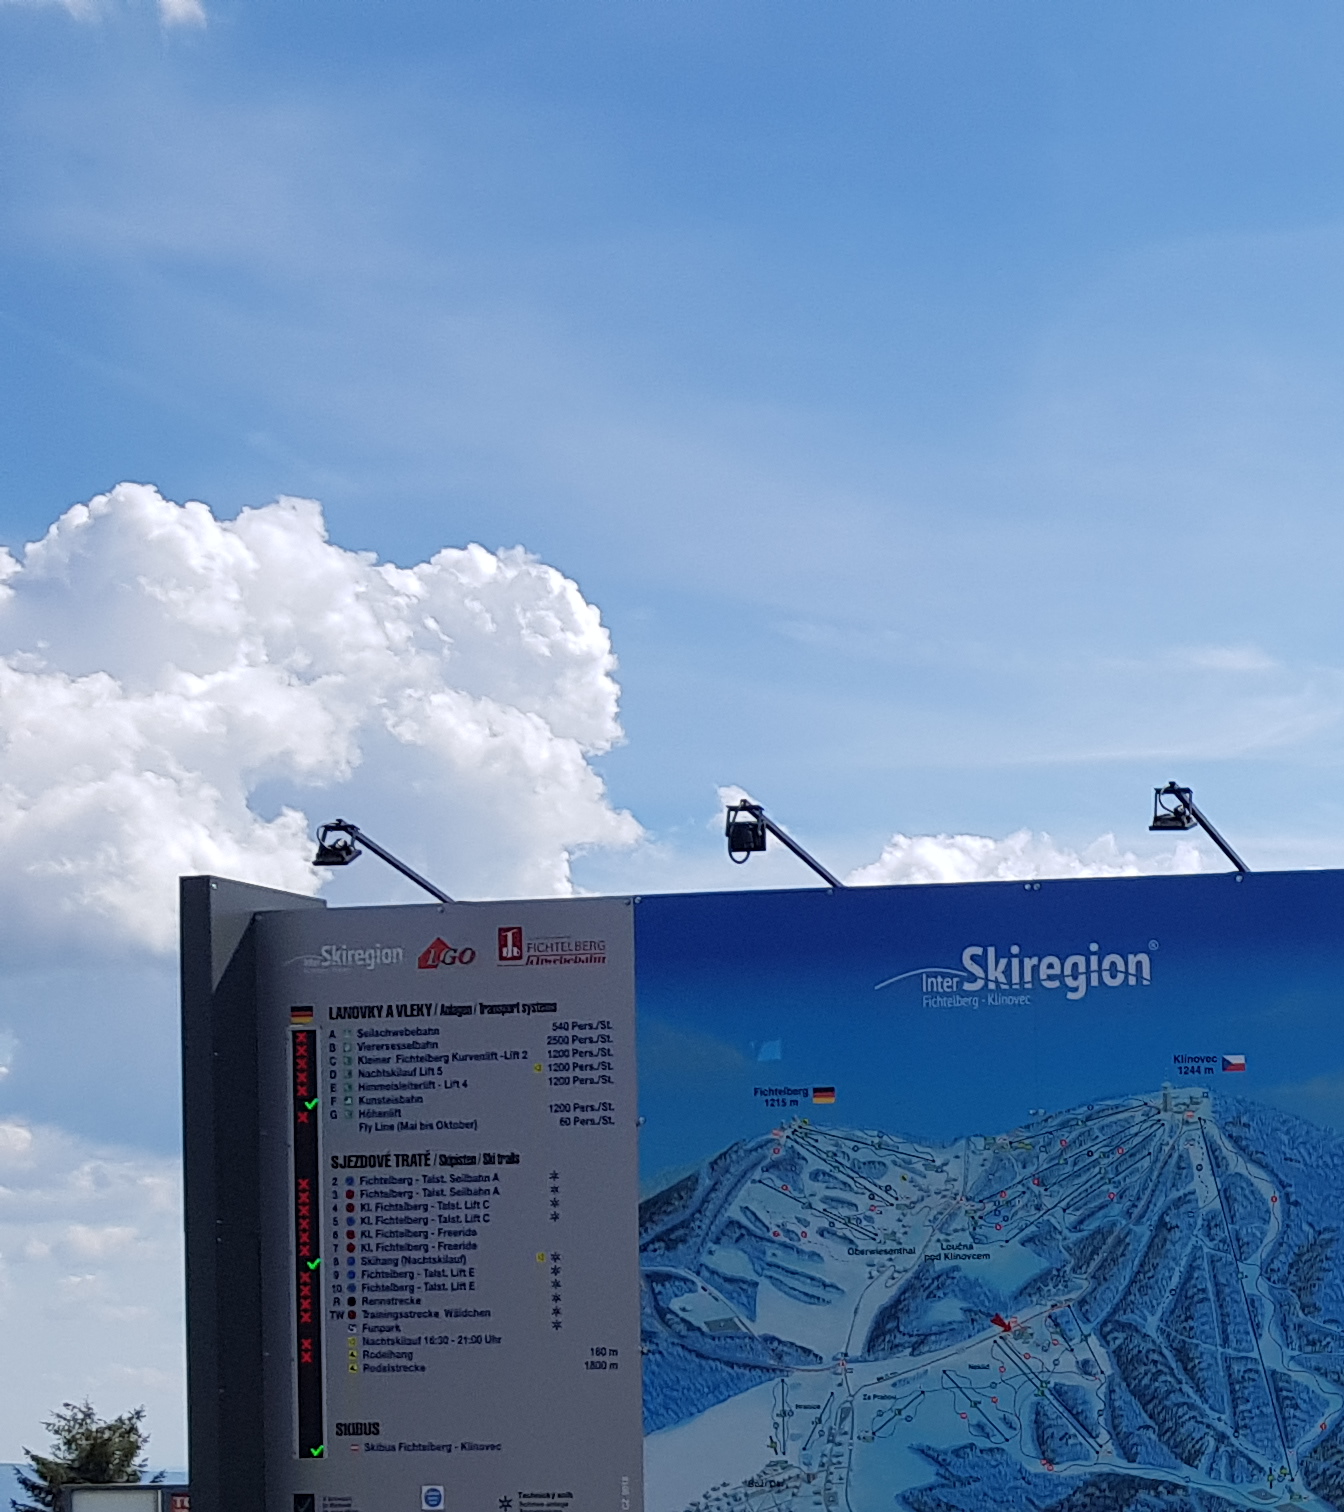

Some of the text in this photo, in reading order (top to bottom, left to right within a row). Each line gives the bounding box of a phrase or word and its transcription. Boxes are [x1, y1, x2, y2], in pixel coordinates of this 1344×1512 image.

[922, 944, 1151, 1000] Inter Skiregion
[921, 994, 978, 1009] Fichtelberg
[329, 1005, 383, 1020] LANOVKY
[396, 1003, 432, 1017] VLEKY
[1178, 1065, 1201, 1074] 1244
[754, 1088, 808, 1098] Fichtelberg
[764, 1098, 786, 1107] 1215
